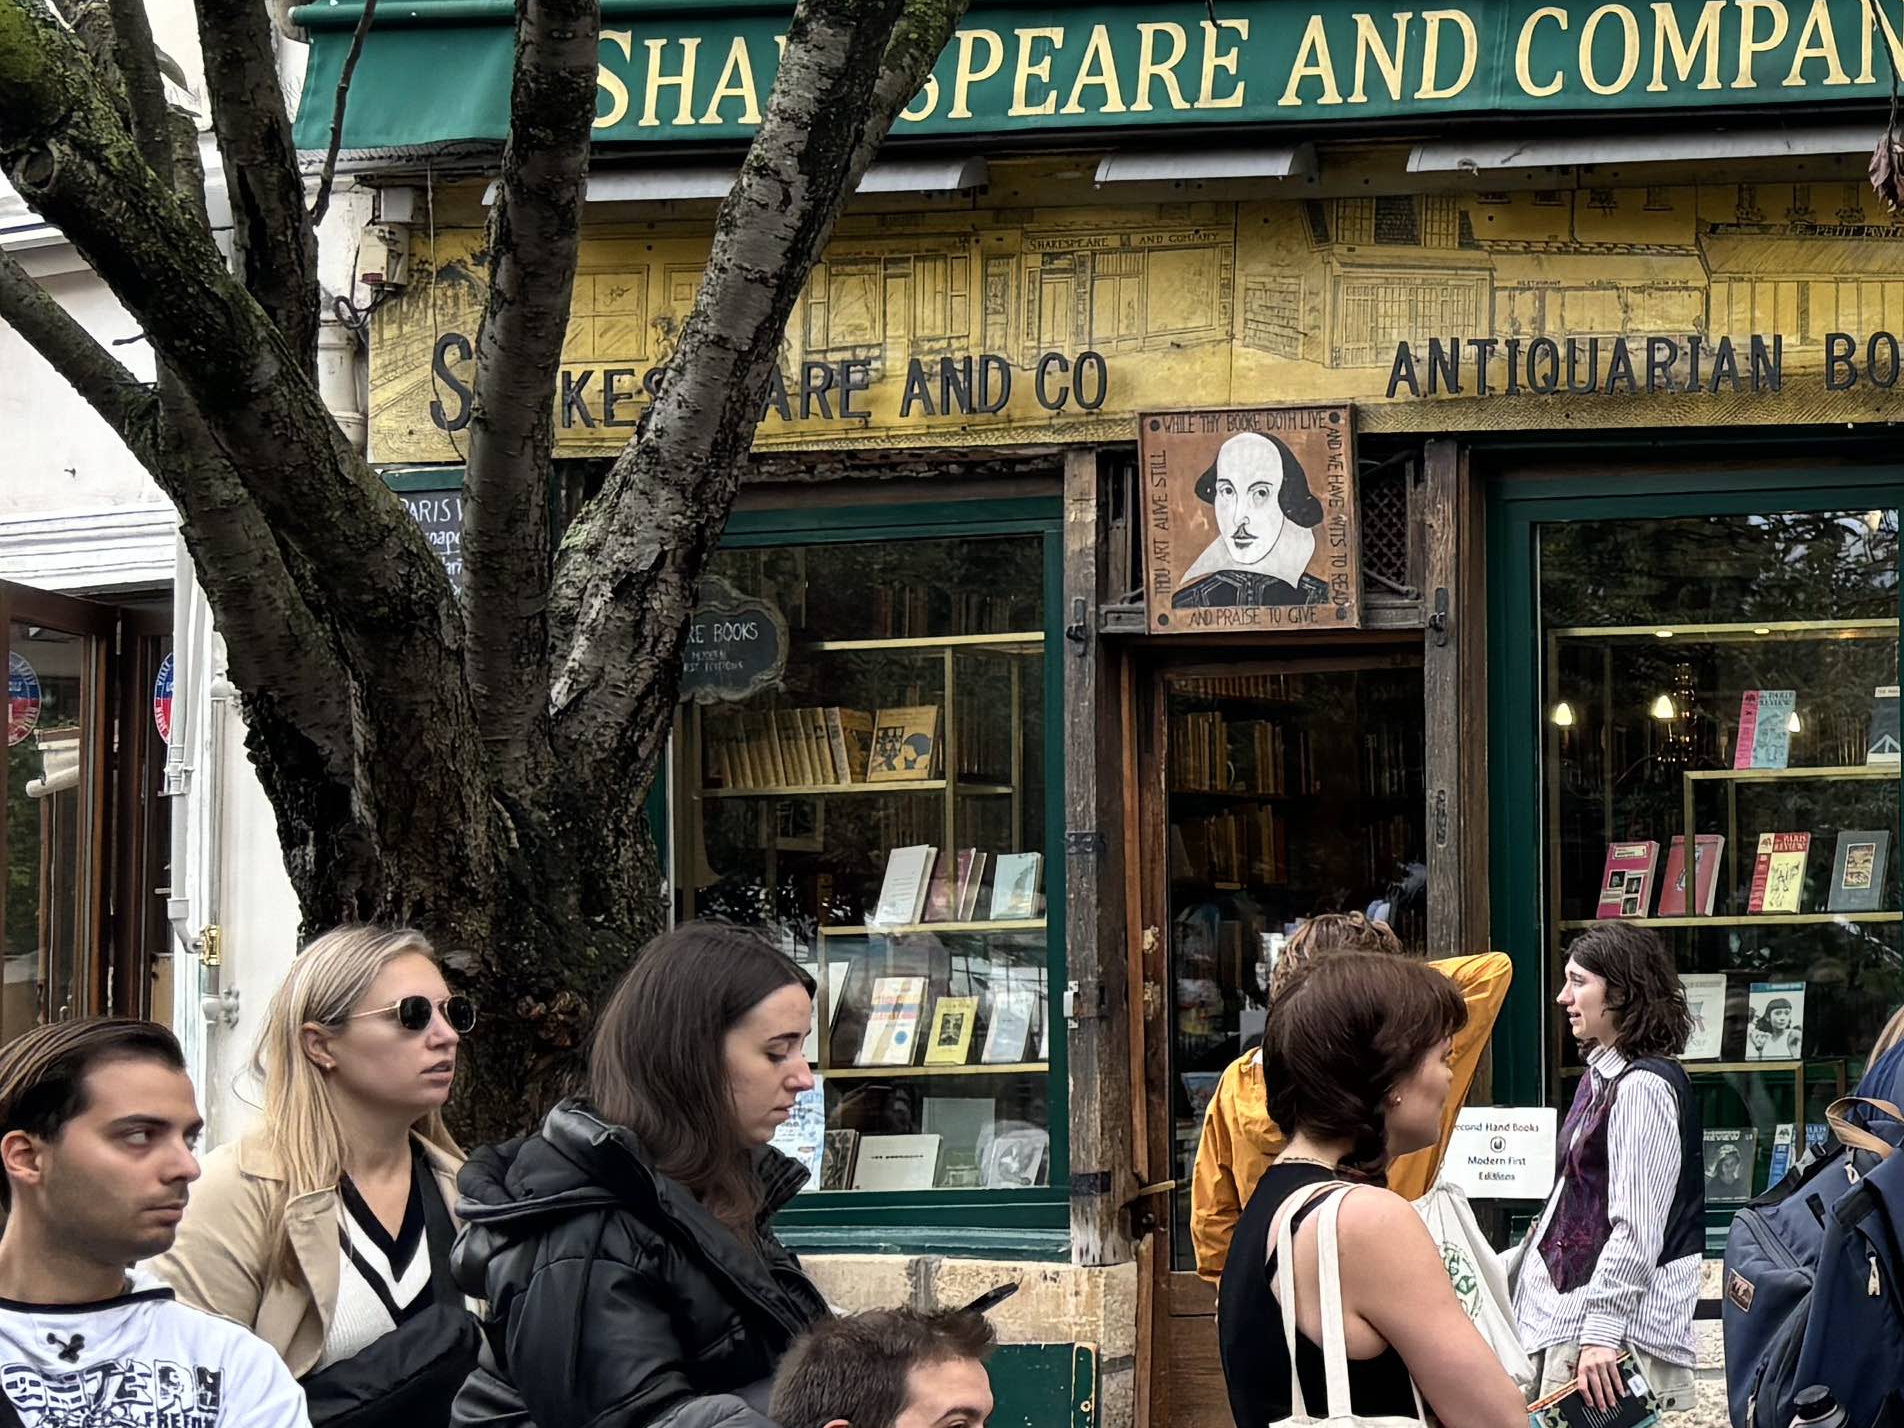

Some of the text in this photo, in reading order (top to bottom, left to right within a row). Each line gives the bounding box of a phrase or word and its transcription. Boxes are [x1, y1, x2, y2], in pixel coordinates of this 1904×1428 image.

[591, 19, 1249, 128] SHAPEARE
[1277, 8, 1478, 106] AND
[1030, 237, 1108, 250] SHAKESPEARE
[1139, 235, 1163, 245] AND
[1386, 333, 1783, 399] ANTIQUARIAN
[429, 332, 1107, 431] SKEARE AND CO
[1163, 411, 1328, 434] WHILE THY BOOKE DOTH LIVE
[1324, 427, 1342, 450] AND
[1150, 450, 1167, 486] STILL
[1328, 453, 1344, 472] WE
[1328, 475, 1345, 508] HAVE
[1152, 493, 1168, 531] ALIVE
[1154, 541, 1170, 564] ART
[1330, 553, 1346, 569] TO
[1330, 573, 1349, 605] READ
[1189, 607, 1318, 627] AND PRAISE TO GIVE
[714, 622, 758, 643] BOOKS
[1468, 1156, 1505, 1165] Modern
